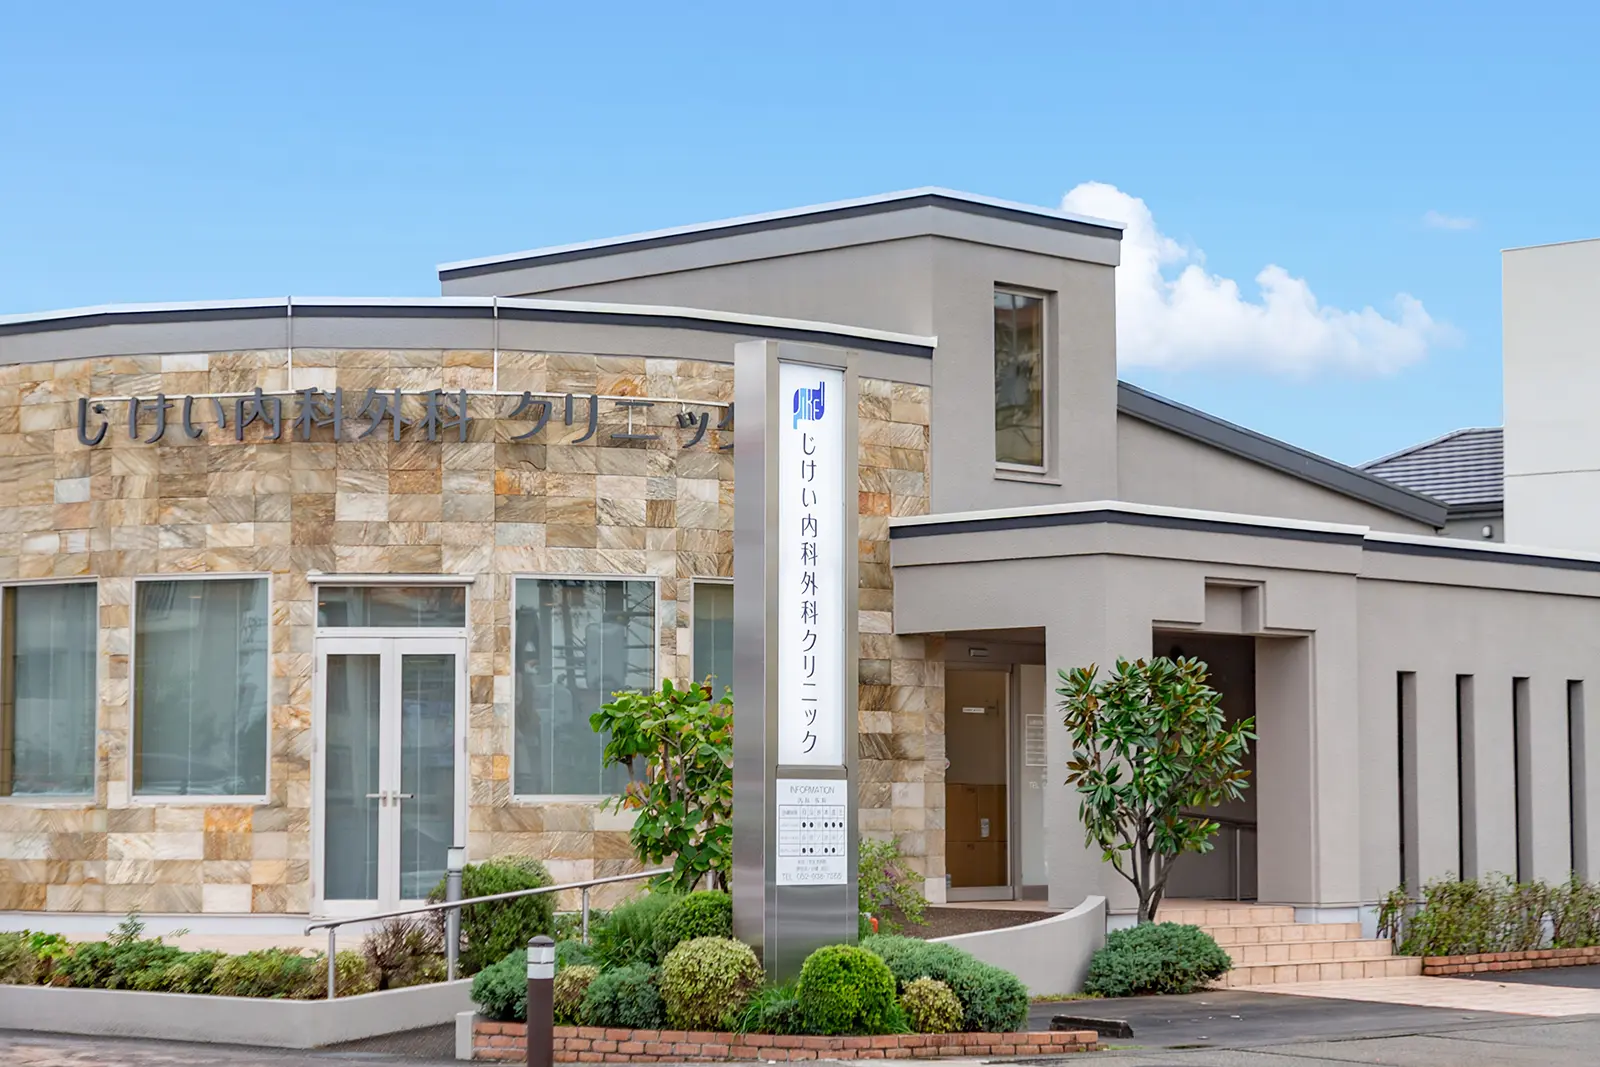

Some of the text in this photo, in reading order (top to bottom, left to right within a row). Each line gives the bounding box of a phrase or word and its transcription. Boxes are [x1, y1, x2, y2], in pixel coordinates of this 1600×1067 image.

[800, 432, 819, 754] じけい内科外科クリニック
[790, 785, 835, 794] INFORMATION
[782, 873, 792, 881] TEL
